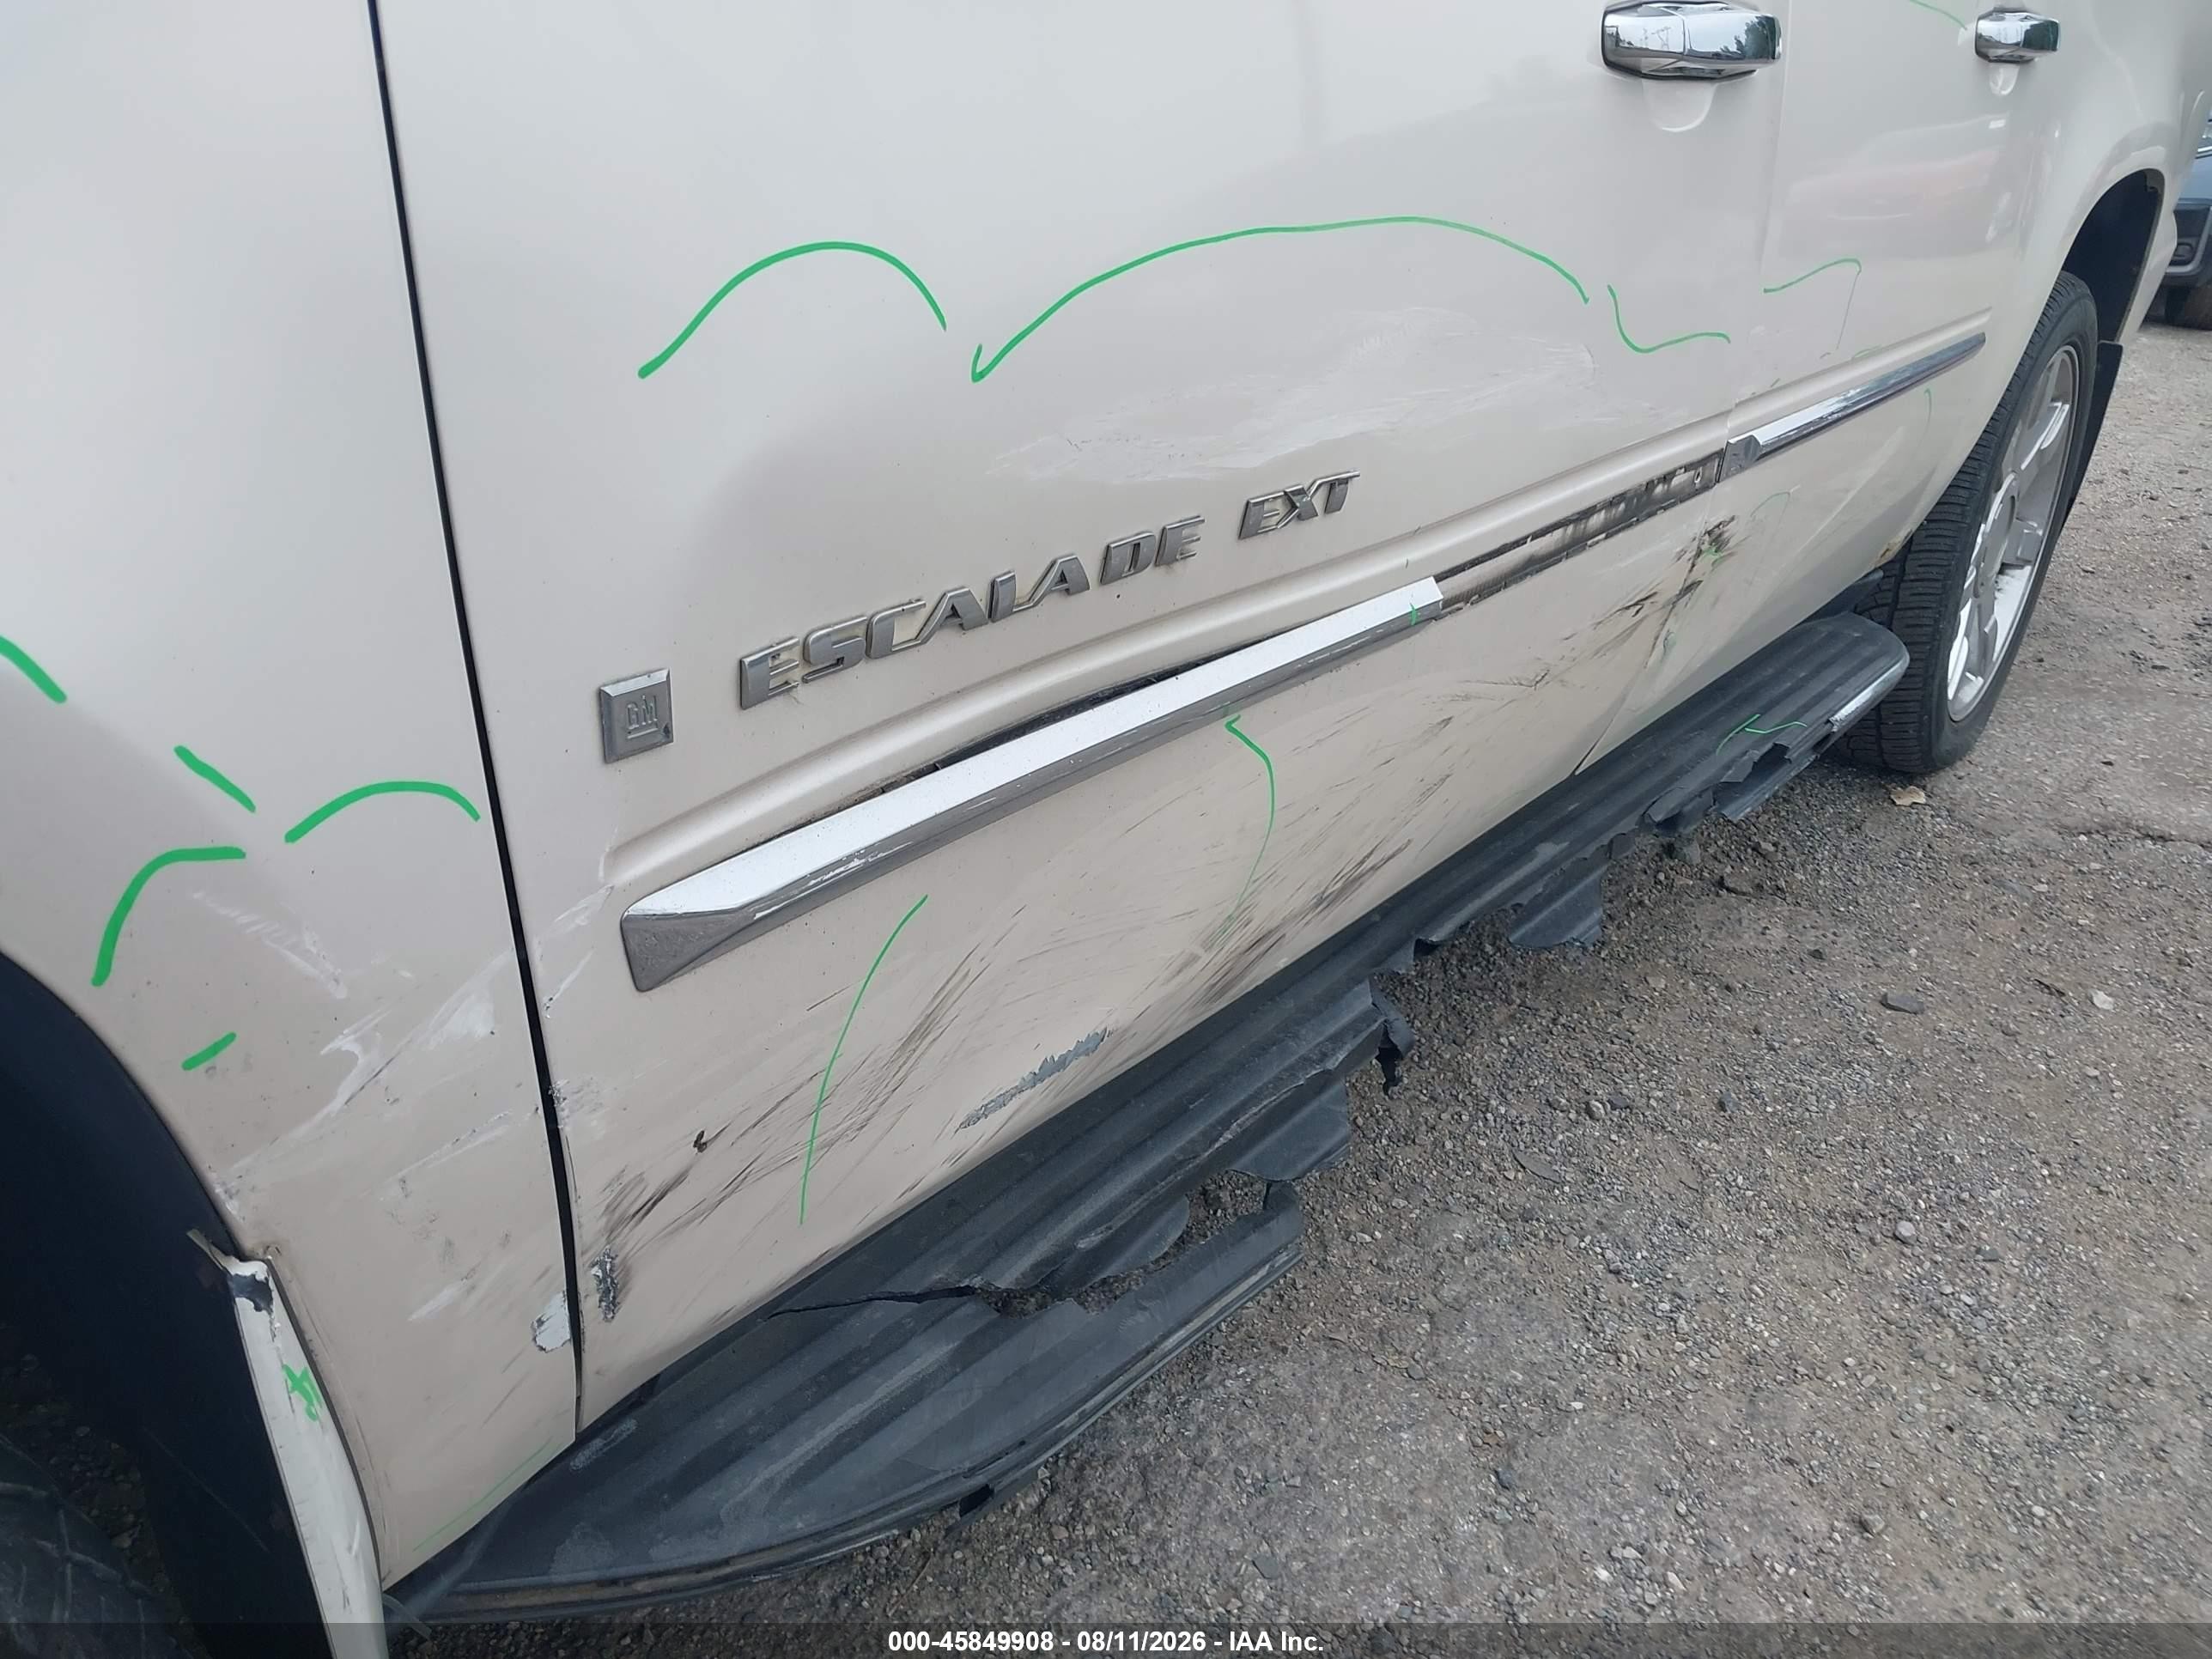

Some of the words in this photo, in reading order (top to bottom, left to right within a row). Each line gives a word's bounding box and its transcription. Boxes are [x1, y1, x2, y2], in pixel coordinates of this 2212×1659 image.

[739, 514, 1206, 710] ESCALADE
[1237, 470, 1361, 540] EXT
[625, 694, 659, 734] GM
